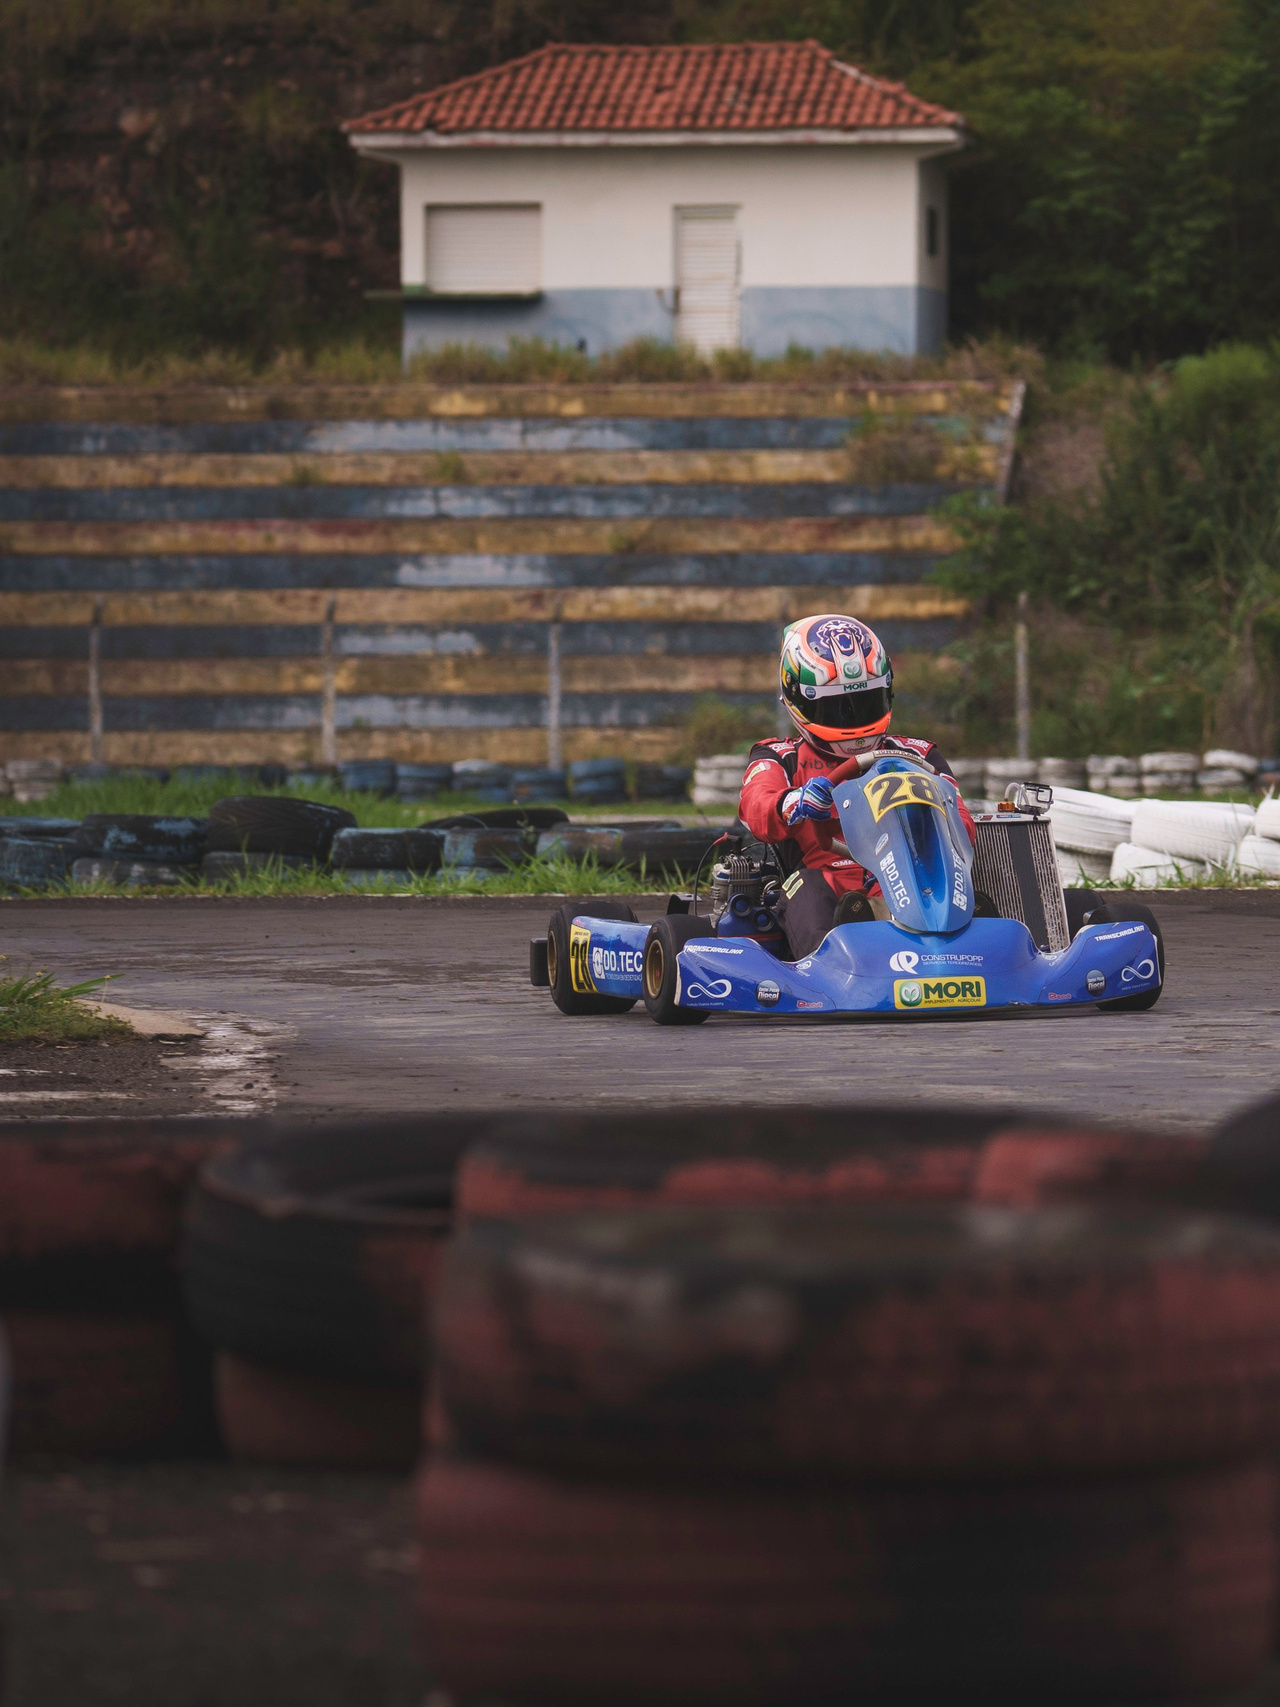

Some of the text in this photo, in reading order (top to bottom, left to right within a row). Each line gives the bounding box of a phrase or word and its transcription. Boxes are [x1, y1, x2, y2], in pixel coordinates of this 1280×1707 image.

[843, 681, 868, 692] MORI
[871, 775, 944, 816] 28
[831, 859, 854, 867] OMP
[885, 864, 911, 908] DD.TEC
[1094, 925, 1145, 942] TRANSCAROLINA
[684, 945, 744, 955] TRANSCAROLINA
[920, 954, 984, 963] CONSTRUPOPP
[571, 937, 597, 992] 28
[603, 950, 643, 973] DD.TEC
[757, 991, 780, 1000] Diesel
[923, 981, 982, 999] MORI
